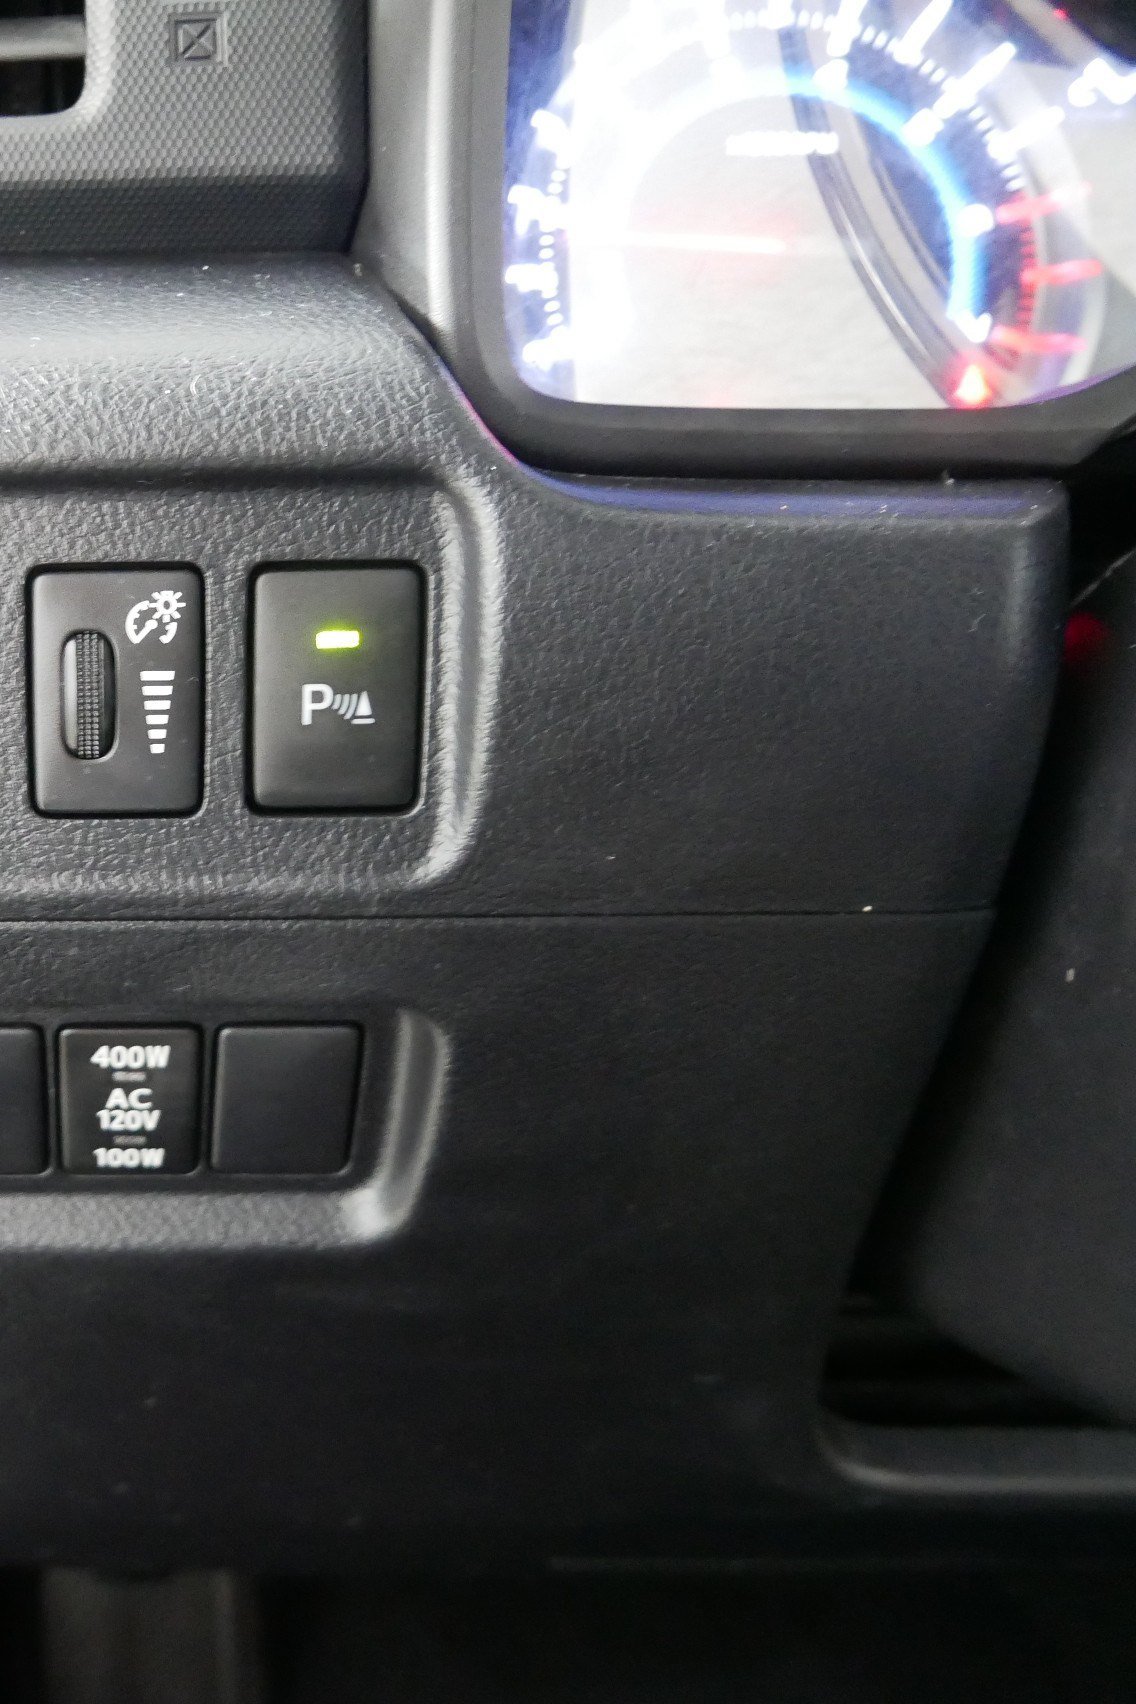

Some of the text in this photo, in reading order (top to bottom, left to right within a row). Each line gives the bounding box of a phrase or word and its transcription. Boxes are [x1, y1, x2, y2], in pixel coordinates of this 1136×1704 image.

[301, 683, 333, 725] P
[90, 1044, 171, 1069] 400W
[105, 1087, 153, 1110] AC
[96, 1109, 161, 1132] 120V
[93, 1147, 165, 1169] 100W
